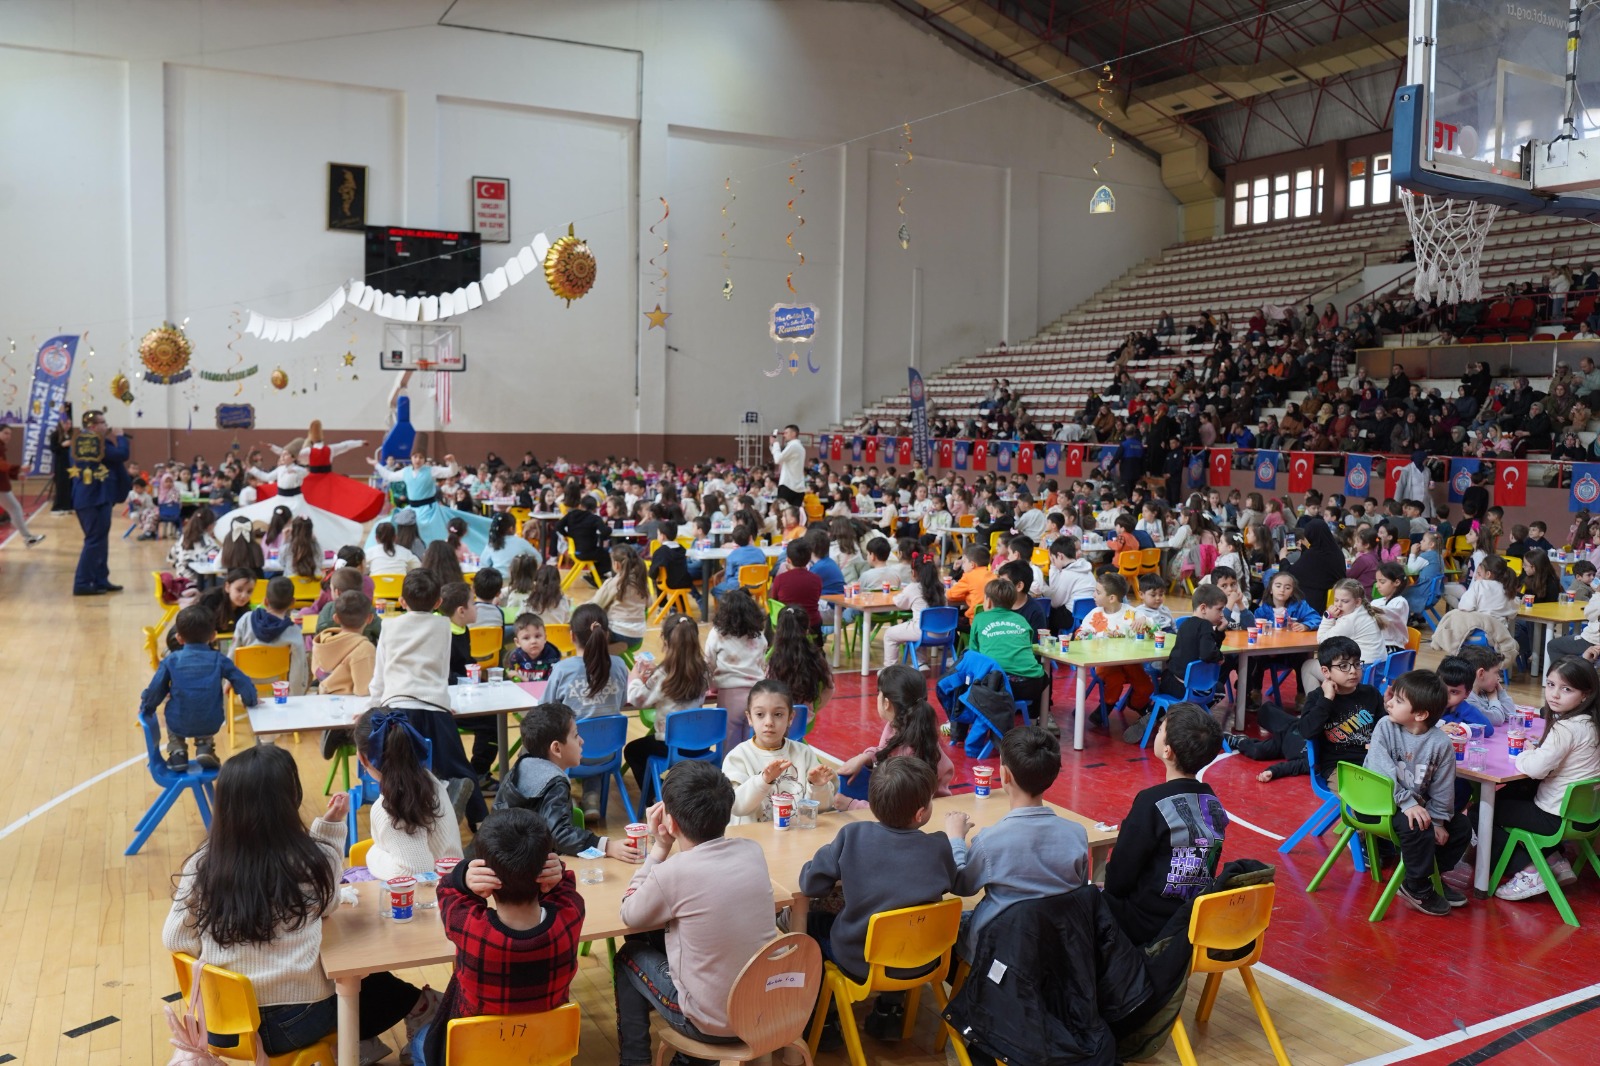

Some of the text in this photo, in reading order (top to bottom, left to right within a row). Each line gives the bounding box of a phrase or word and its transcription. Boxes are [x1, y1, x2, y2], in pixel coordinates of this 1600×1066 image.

[569, 683, 619, 698] A GOD
[1324, 709, 1373, 743] REWIND
